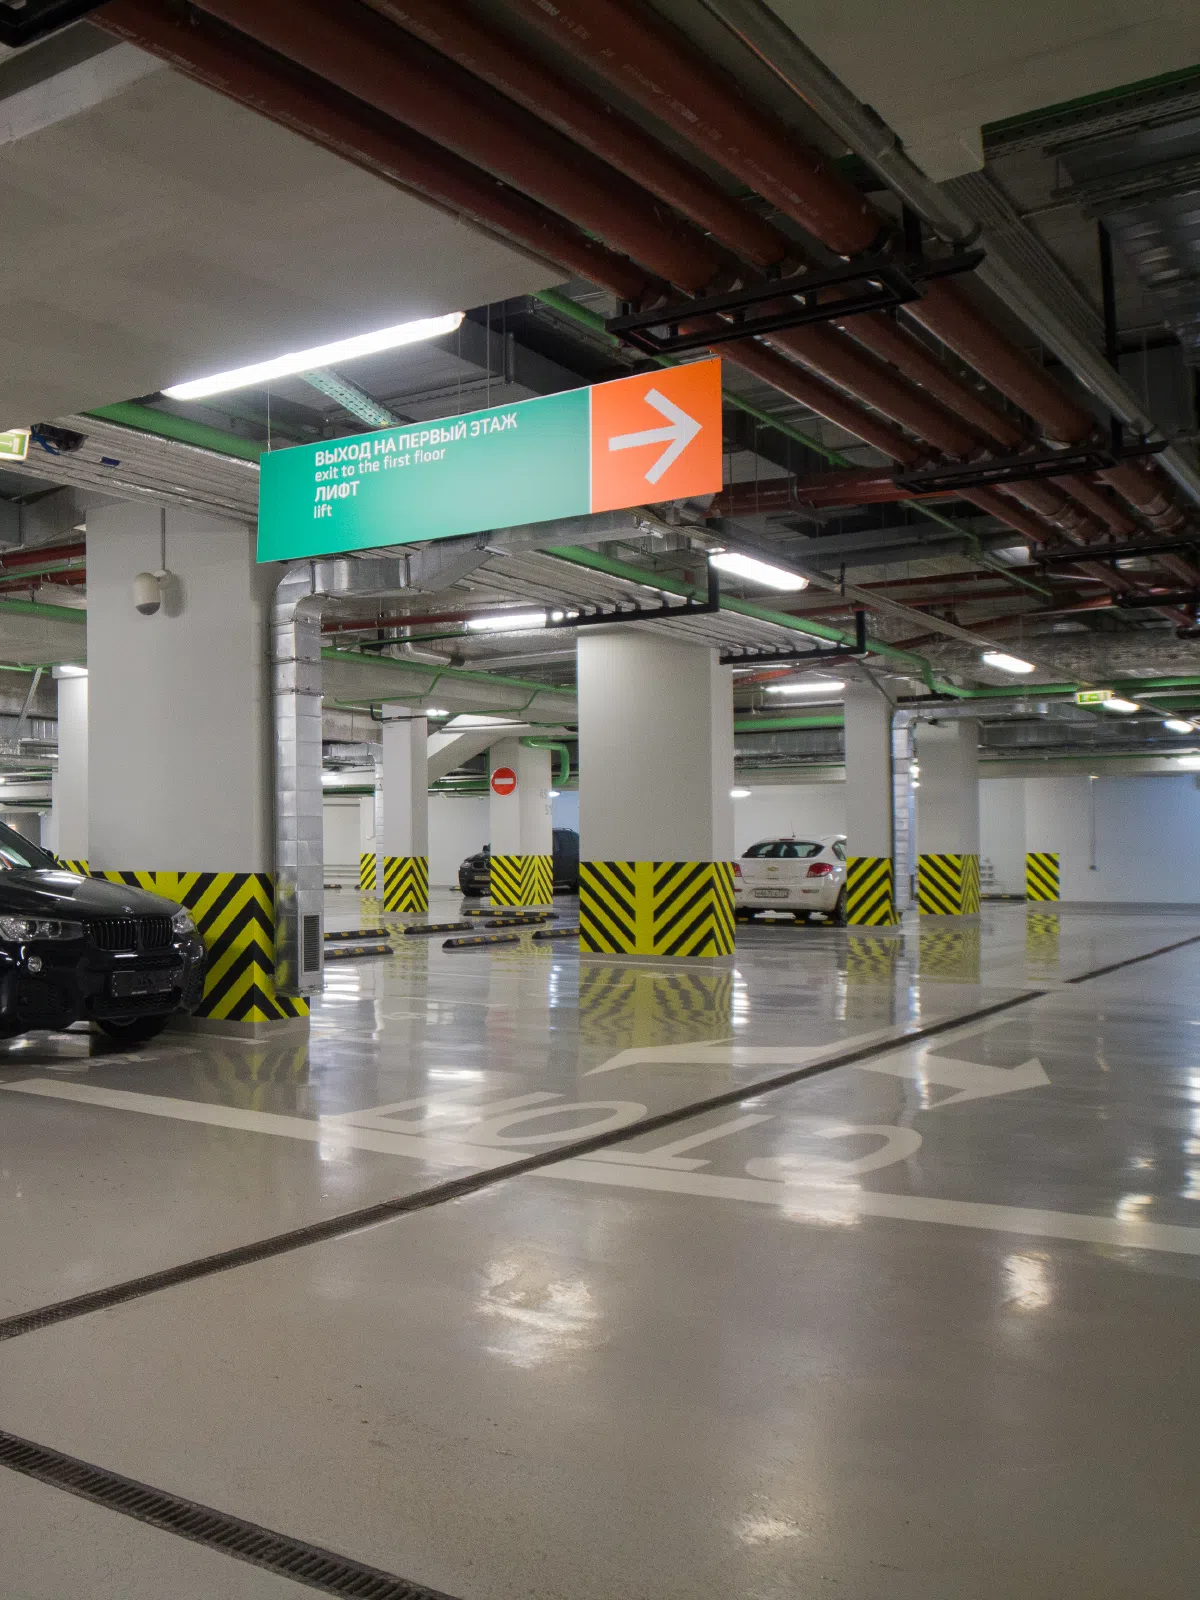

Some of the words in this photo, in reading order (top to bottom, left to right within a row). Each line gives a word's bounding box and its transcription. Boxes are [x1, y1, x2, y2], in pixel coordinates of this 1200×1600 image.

[315, 443, 372, 467] ВЫХОД
[374, 439, 397, 456] НА
[400, 420, 467, 451] ПЕРВЫЙ
[470, 412, 518, 437] ЭТАЖ
[315, 465, 339, 482] exit
[341, 464, 355, 478] to
[358, 459, 380, 475] the
[384, 453, 411, 470] first
[414, 448, 446, 465] floor
[314, 480, 360, 502] ЛИФТ
[313, 504, 333, 519] lift
